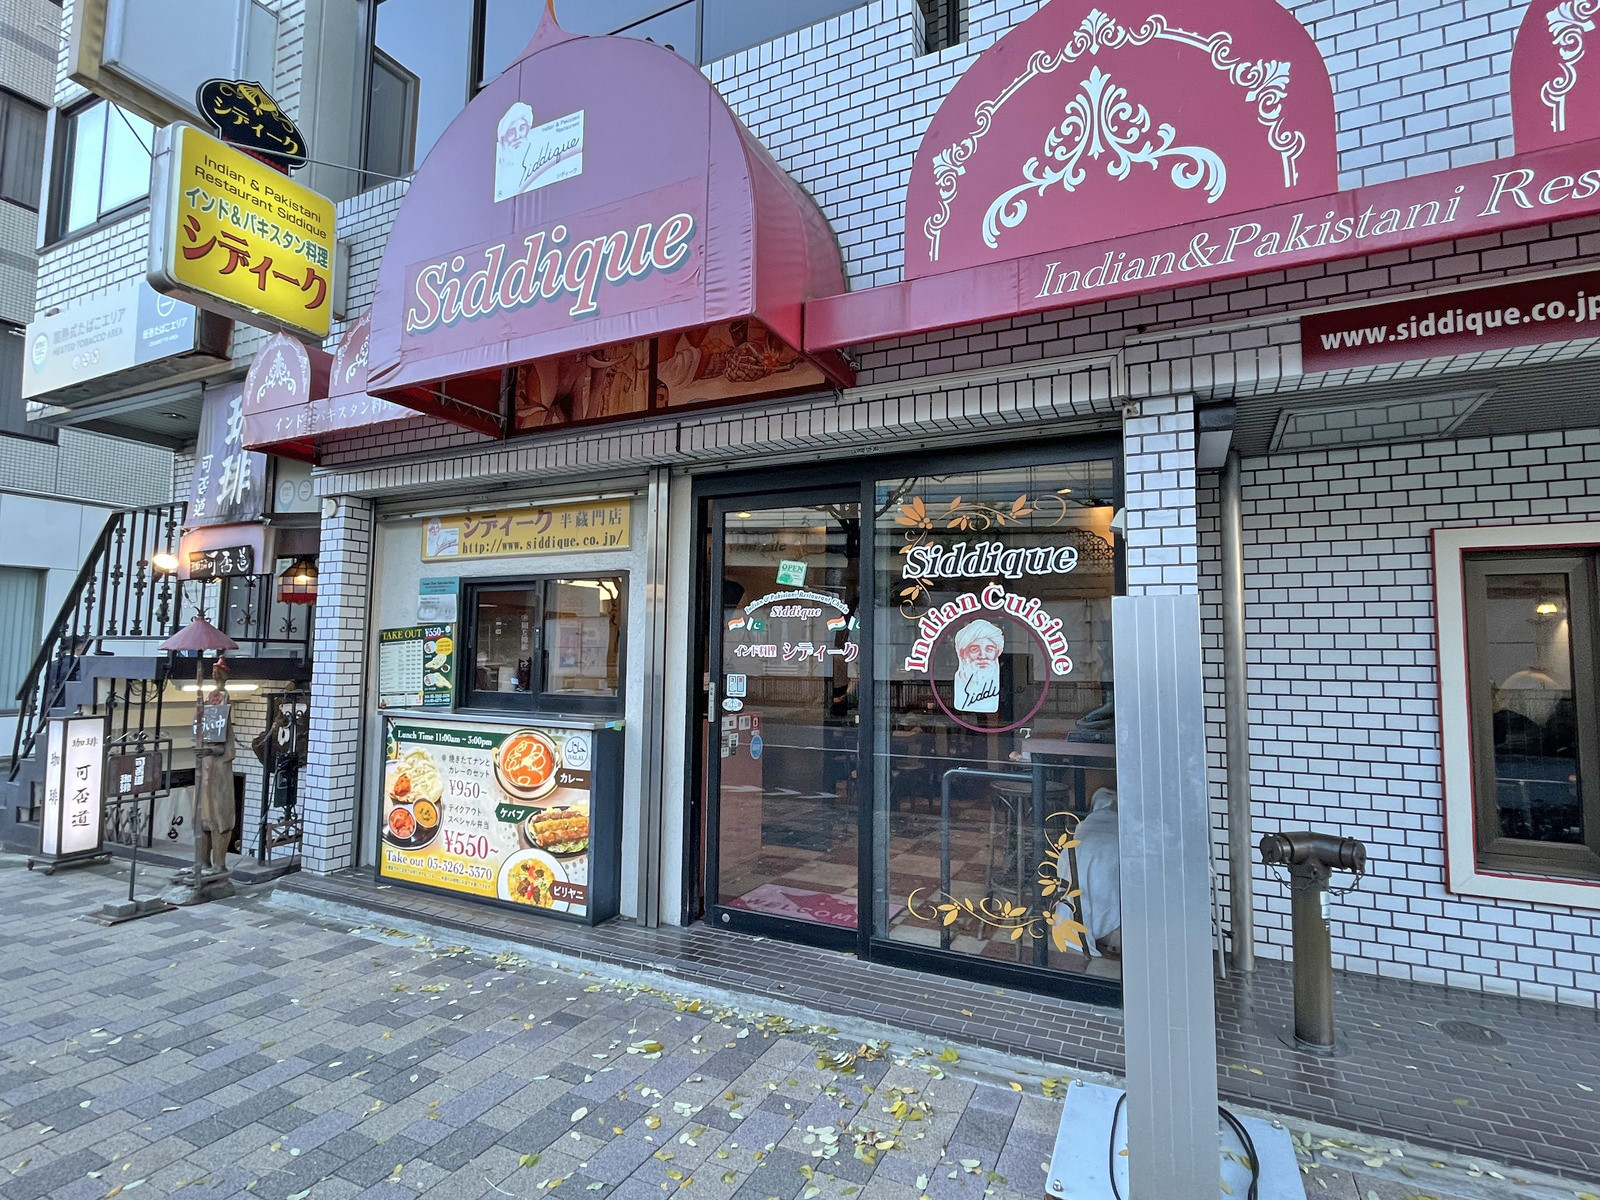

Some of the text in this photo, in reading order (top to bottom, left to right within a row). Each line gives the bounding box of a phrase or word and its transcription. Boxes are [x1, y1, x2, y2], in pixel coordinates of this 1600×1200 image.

[213, 95, 298, 155] シディーク
[519, 137, 580, 187] Siddique
[204, 155, 322, 223] Indian & Pakistani
[1476, 168, 1600, 218] Res
[194, 165, 328, 240] Restaurant Siddique
[182, 214, 327, 310] シディーク
[406, 212, 697, 334] Siddique
[464, 508, 622, 539] シディーク 半蔵門店
[781, 563, 804, 573] OPEN
[902, 541, 1078, 579] Siddique
[744, 599, 765, 615] Indian
[770, 590, 799, 601] Pakistani
[798, 590, 832, 604] Restaurant
[770, 605, 822, 620] Siddique
[382, 629, 422, 640] TAKE OUT
[904, 584, 1073, 676] Indian Cuisine
[734, 645, 777, 658] インド料理
[72, 736, 98, 748] 珈琲
[397, 730, 417, 740] Lunch
[418, 731, 434, 741] Time
[435, 733, 461, 744] 11:00am
[448, 754, 490, 767] 焼きたてナンと
[448, 766, 490, 778] カレーのセット
[560, 773, 584, 783] カレー
[72, 764, 92, 828] 可否道
[448, 804, 482, 816] テイクアウト
[499, 807, 525, 820] ケバブ
[448, 816, 490, 830] スペシャル弁当
[386, 849, 408, 864] Take
[410, 857, 424, 867] out
[427, 857, 493, 881] 03-3262-3370
[553, 885, 584, 900] ビリヤニ
[747, 897, 858, 924] WELCOM
